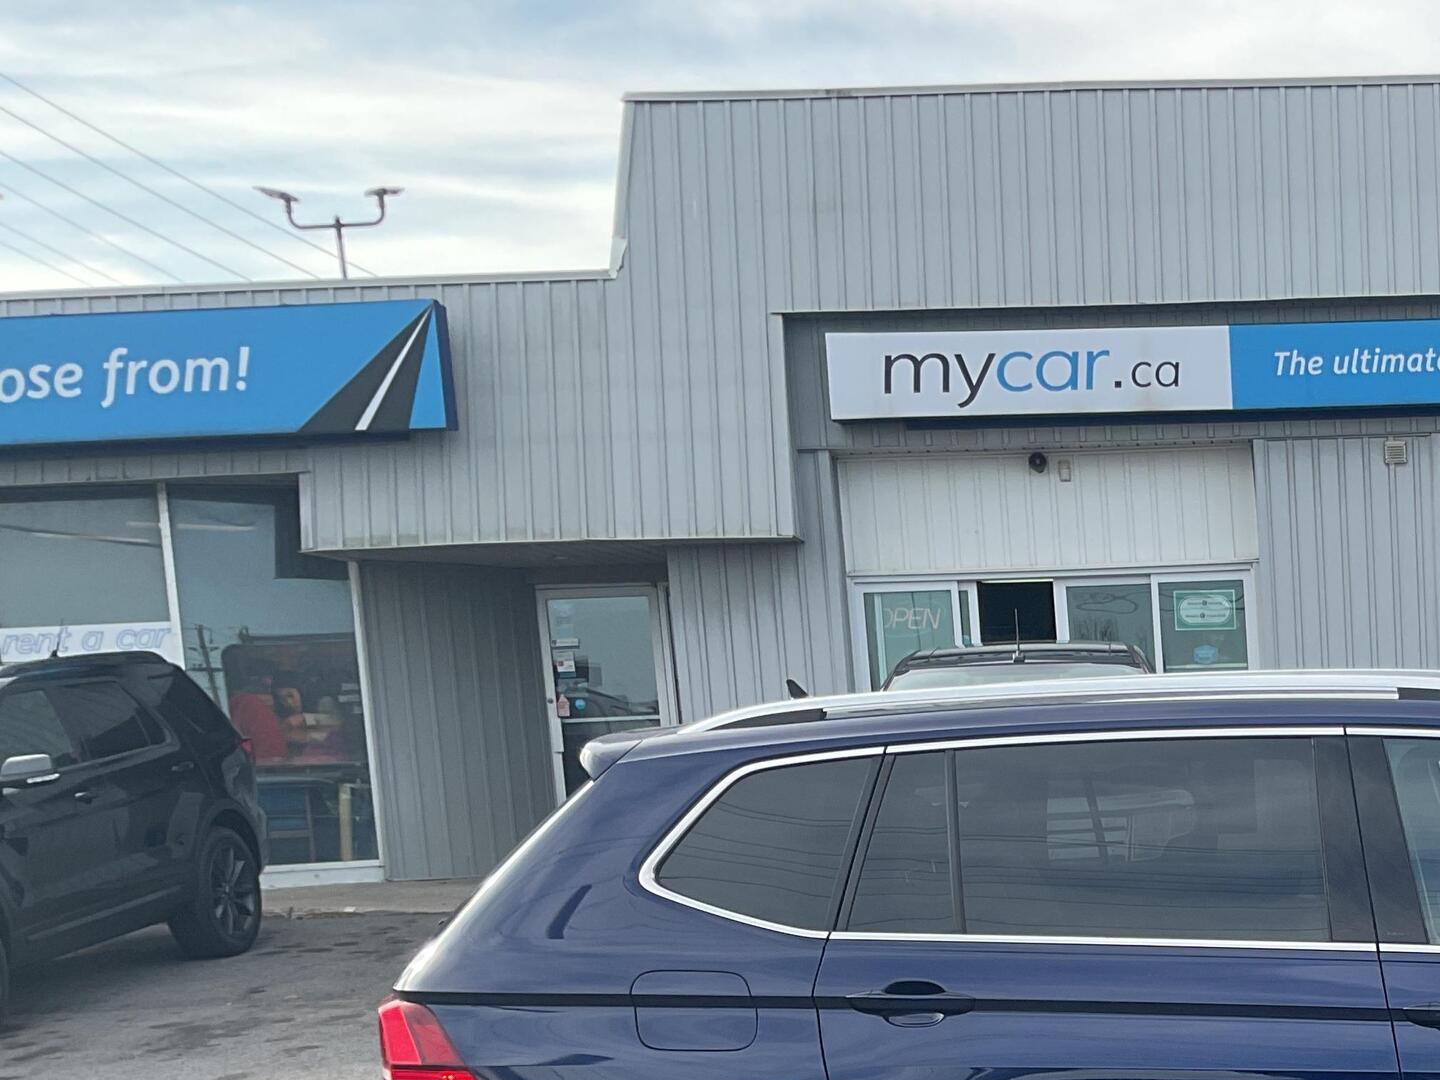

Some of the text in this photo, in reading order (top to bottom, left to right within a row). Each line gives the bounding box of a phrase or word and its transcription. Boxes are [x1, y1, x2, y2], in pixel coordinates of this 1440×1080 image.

[1274, 352, 1323, 376] The
[100, 346, 250, 408] from!
[82, 630, 104, 650] a
[116, 627, 171, 650] car
